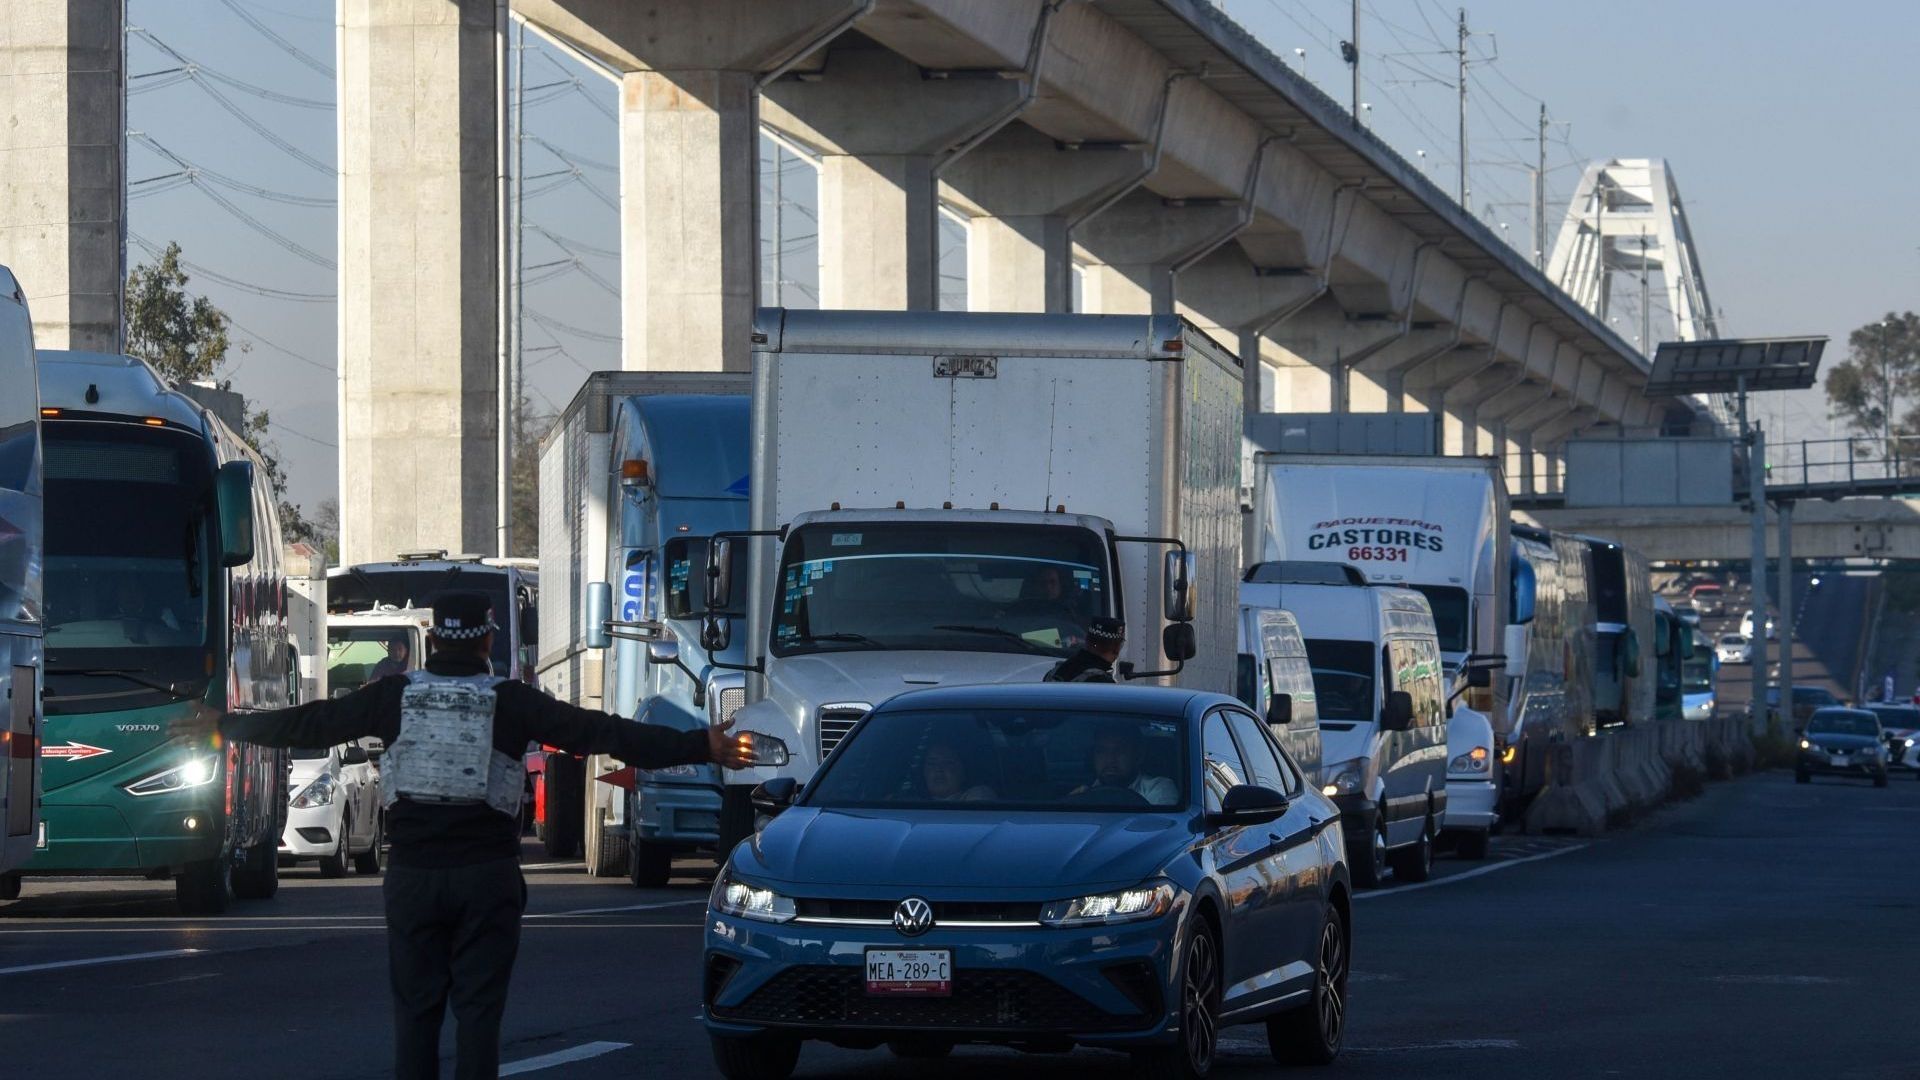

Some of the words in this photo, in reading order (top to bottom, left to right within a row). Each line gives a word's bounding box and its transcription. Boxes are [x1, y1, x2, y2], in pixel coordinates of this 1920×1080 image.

[1313, 517, 1443, 532] PAQUETERIA
[1308, 529, 1444, 552] CASTORES
[1348, 547, 1407, 562] 66331
[869, 962, 948, 980] MEA-289-C
